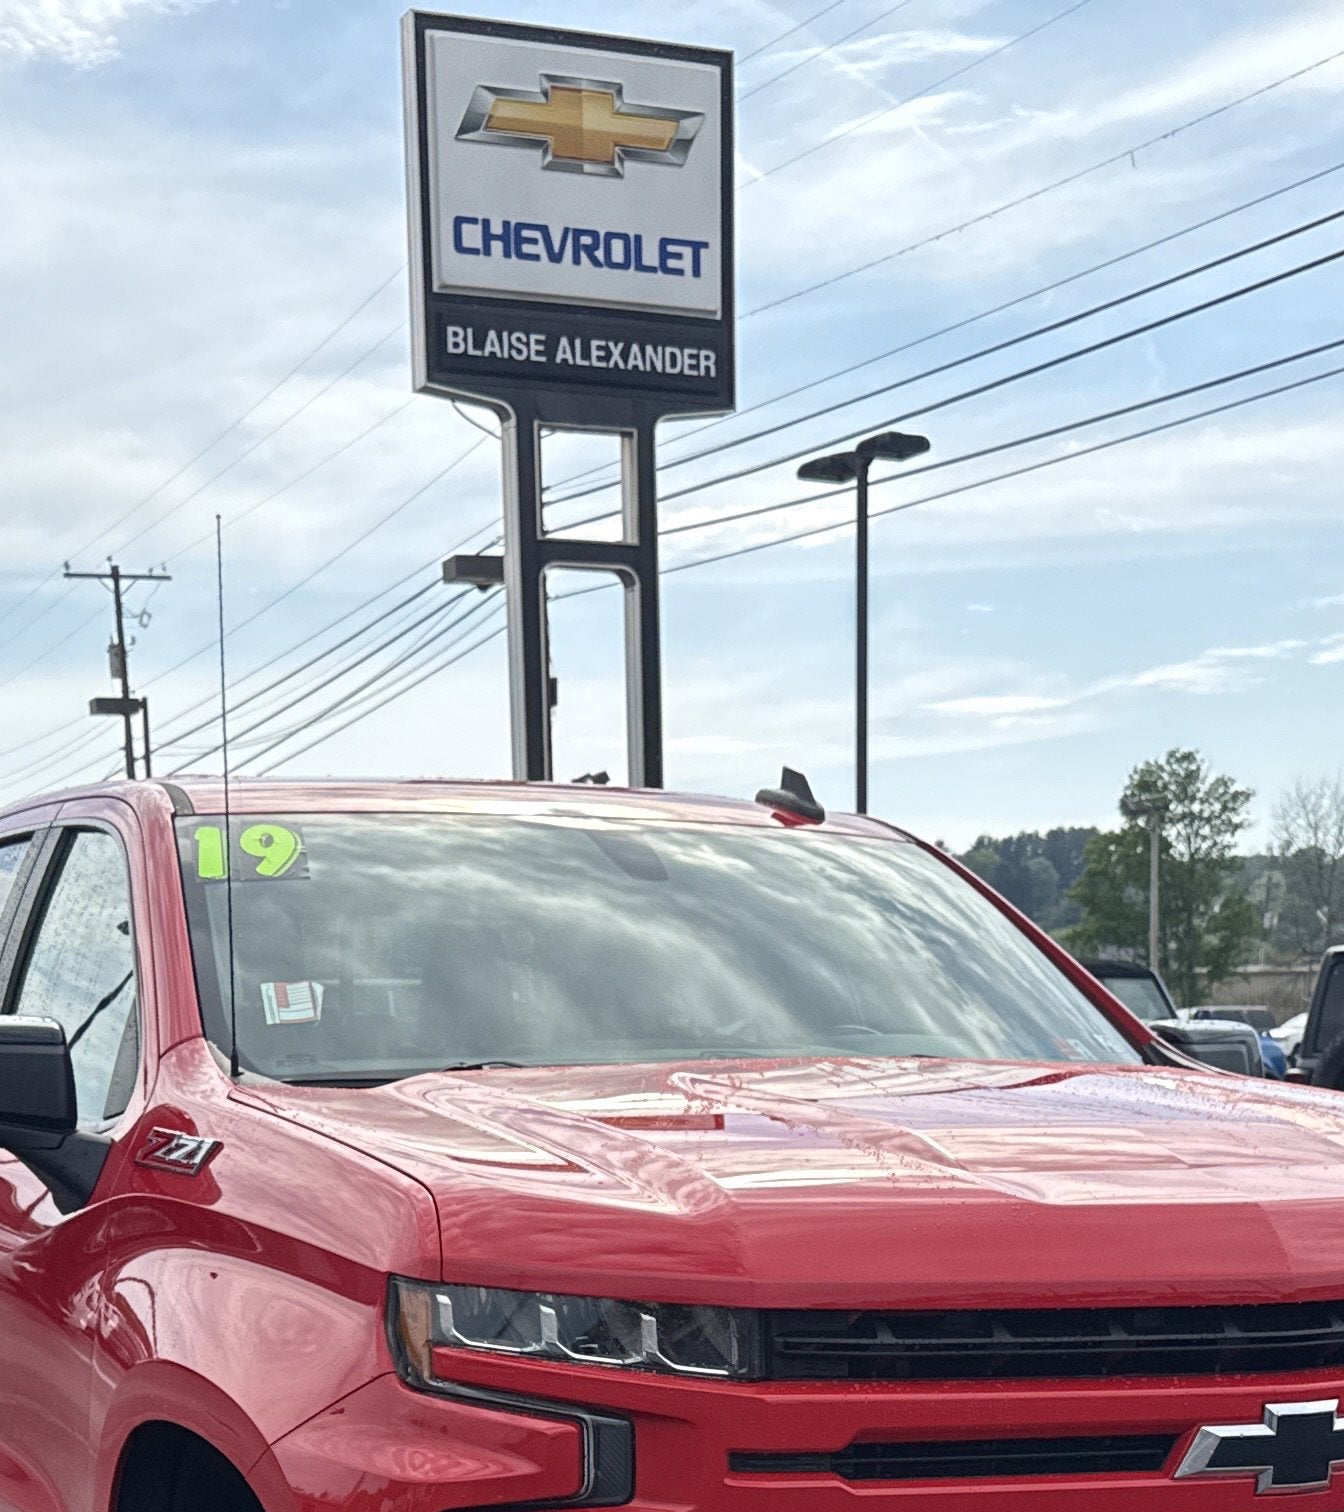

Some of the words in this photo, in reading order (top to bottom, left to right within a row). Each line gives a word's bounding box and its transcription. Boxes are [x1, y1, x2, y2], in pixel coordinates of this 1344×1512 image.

[453, 216, 709, 278] CHEVROLET
[446, 325, 547, 363] BLAISE
[555, 336, 717, 378] ALEXANDER
[194, 823, 304, 879] 19
